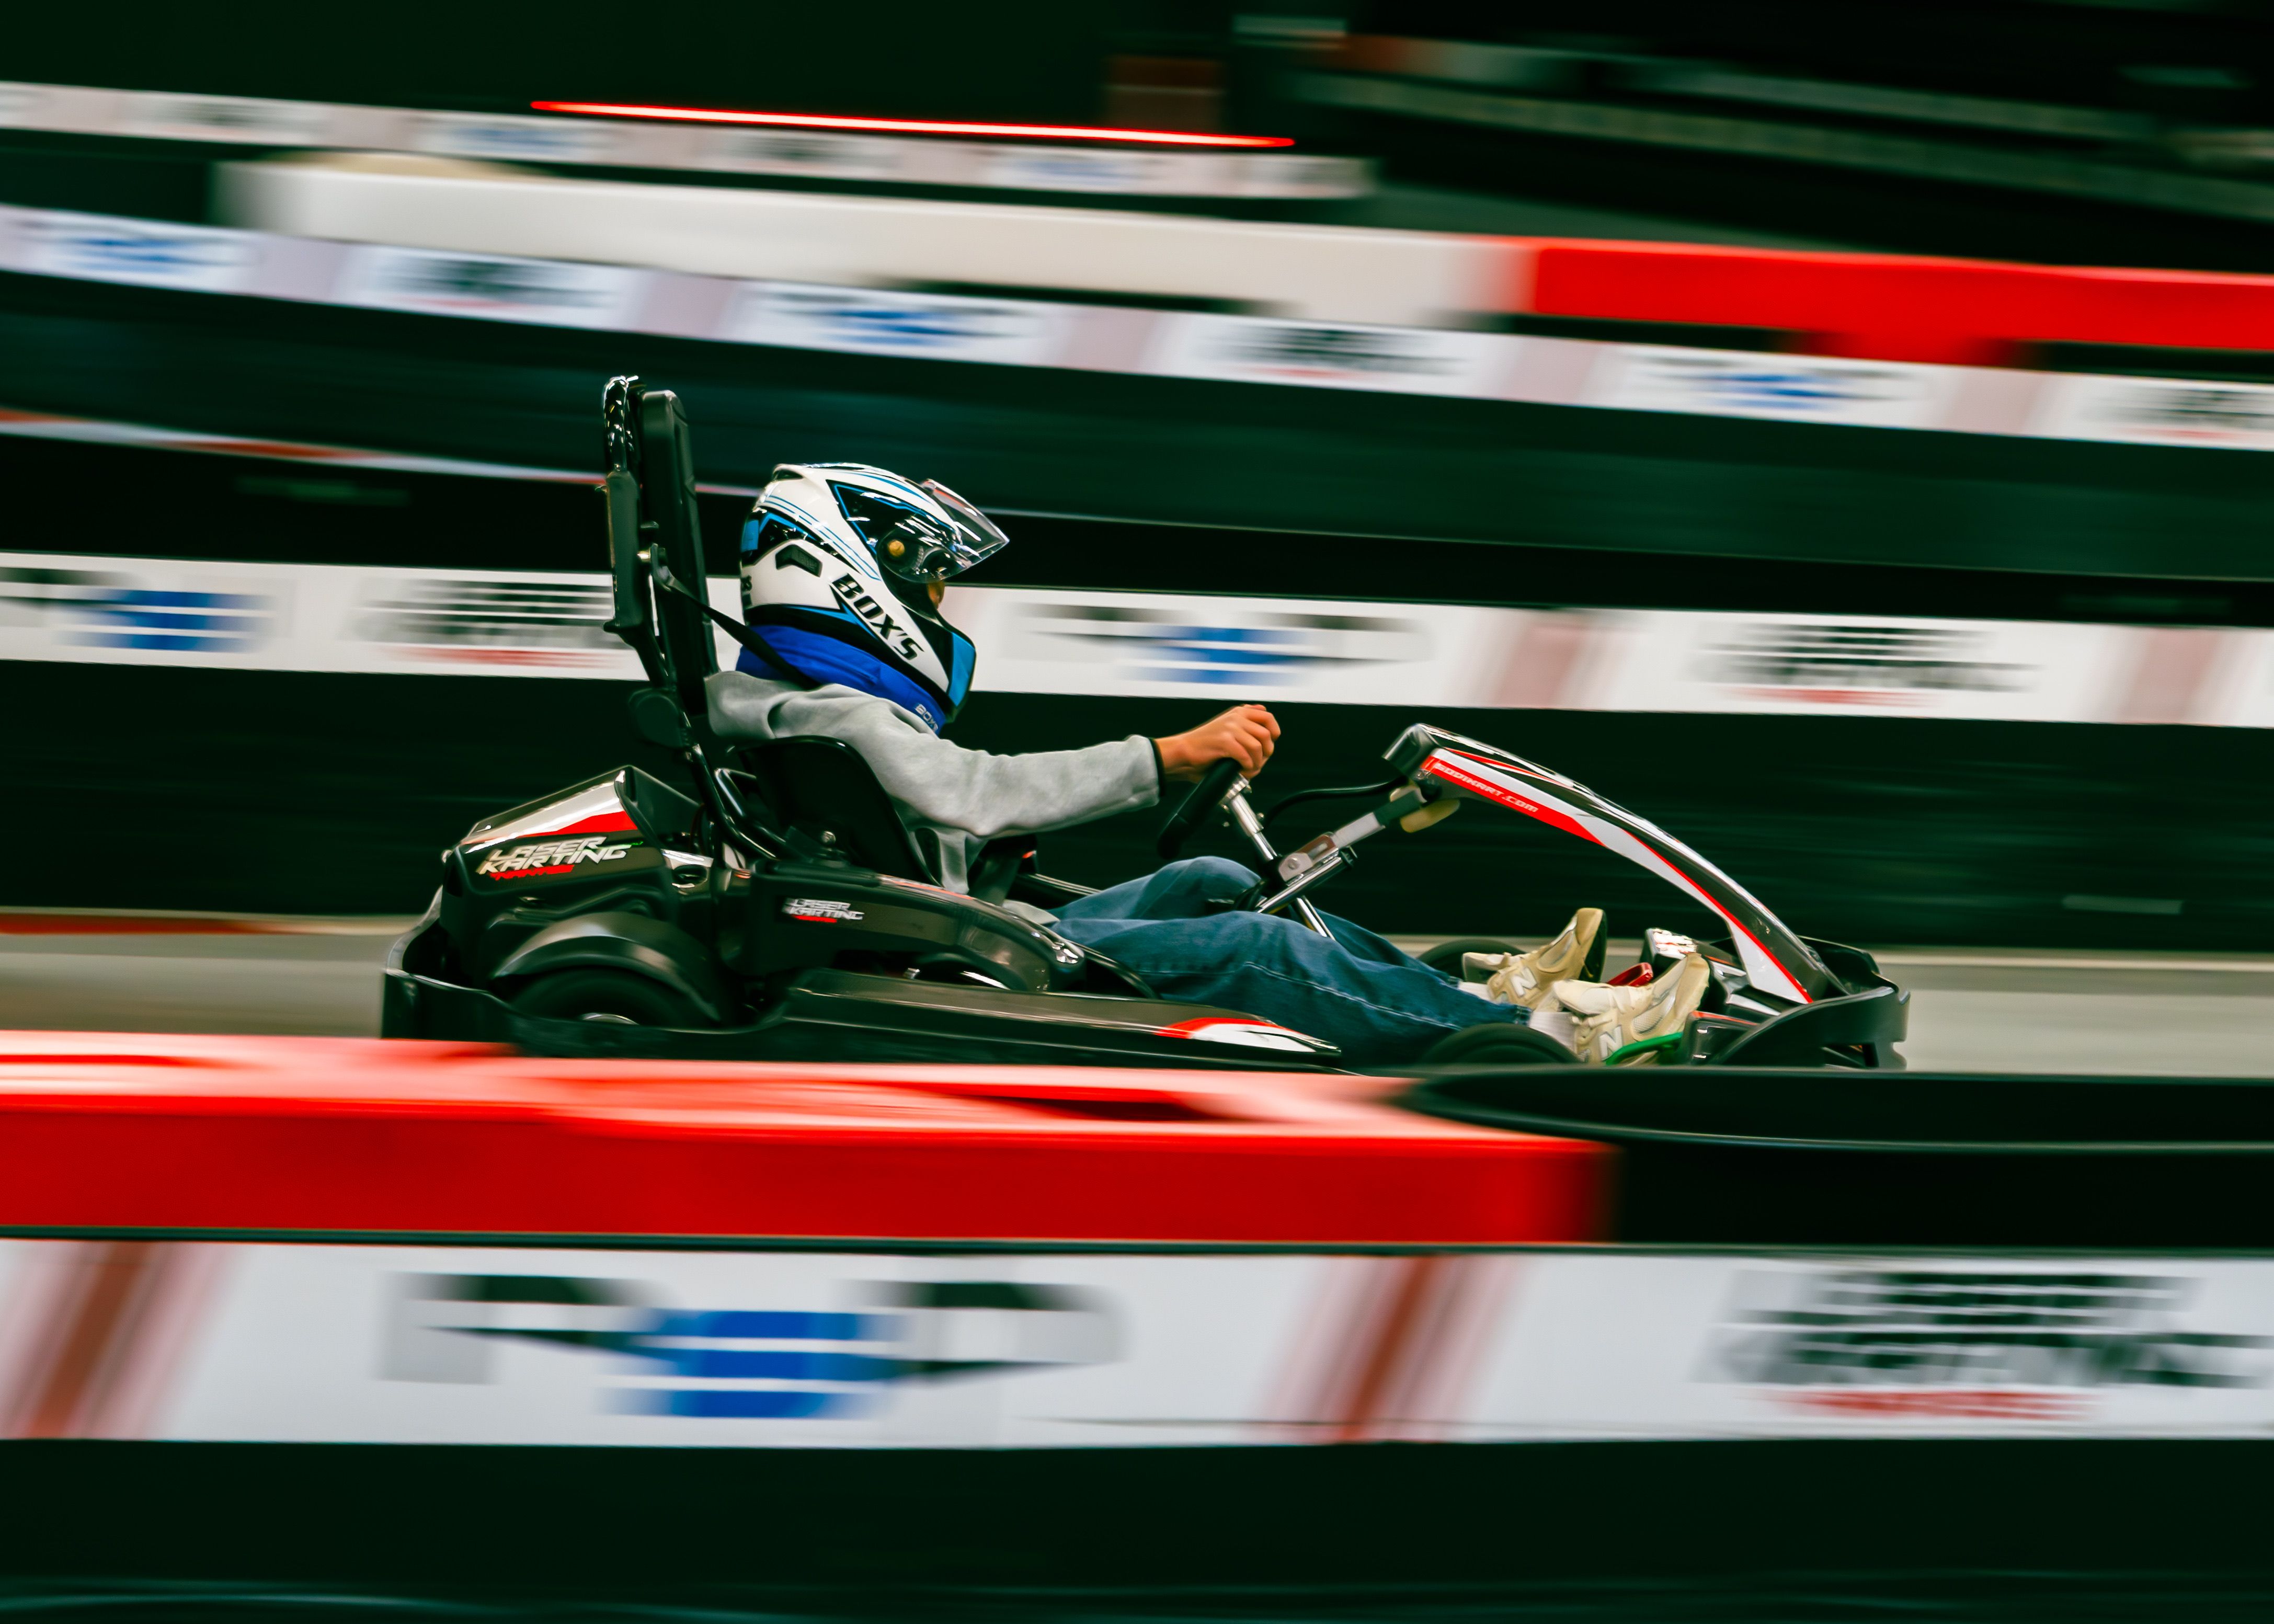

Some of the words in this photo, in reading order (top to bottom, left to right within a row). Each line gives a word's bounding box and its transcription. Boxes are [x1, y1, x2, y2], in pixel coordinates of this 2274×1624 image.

[832, 573, 924, 660] BOX'S
[476, 844, 632, 874] KARTING
[487, 836, 607, 862] LASER
[784, 906, 864, 920] KARTING
[788, 898, 851, 911] LASER
